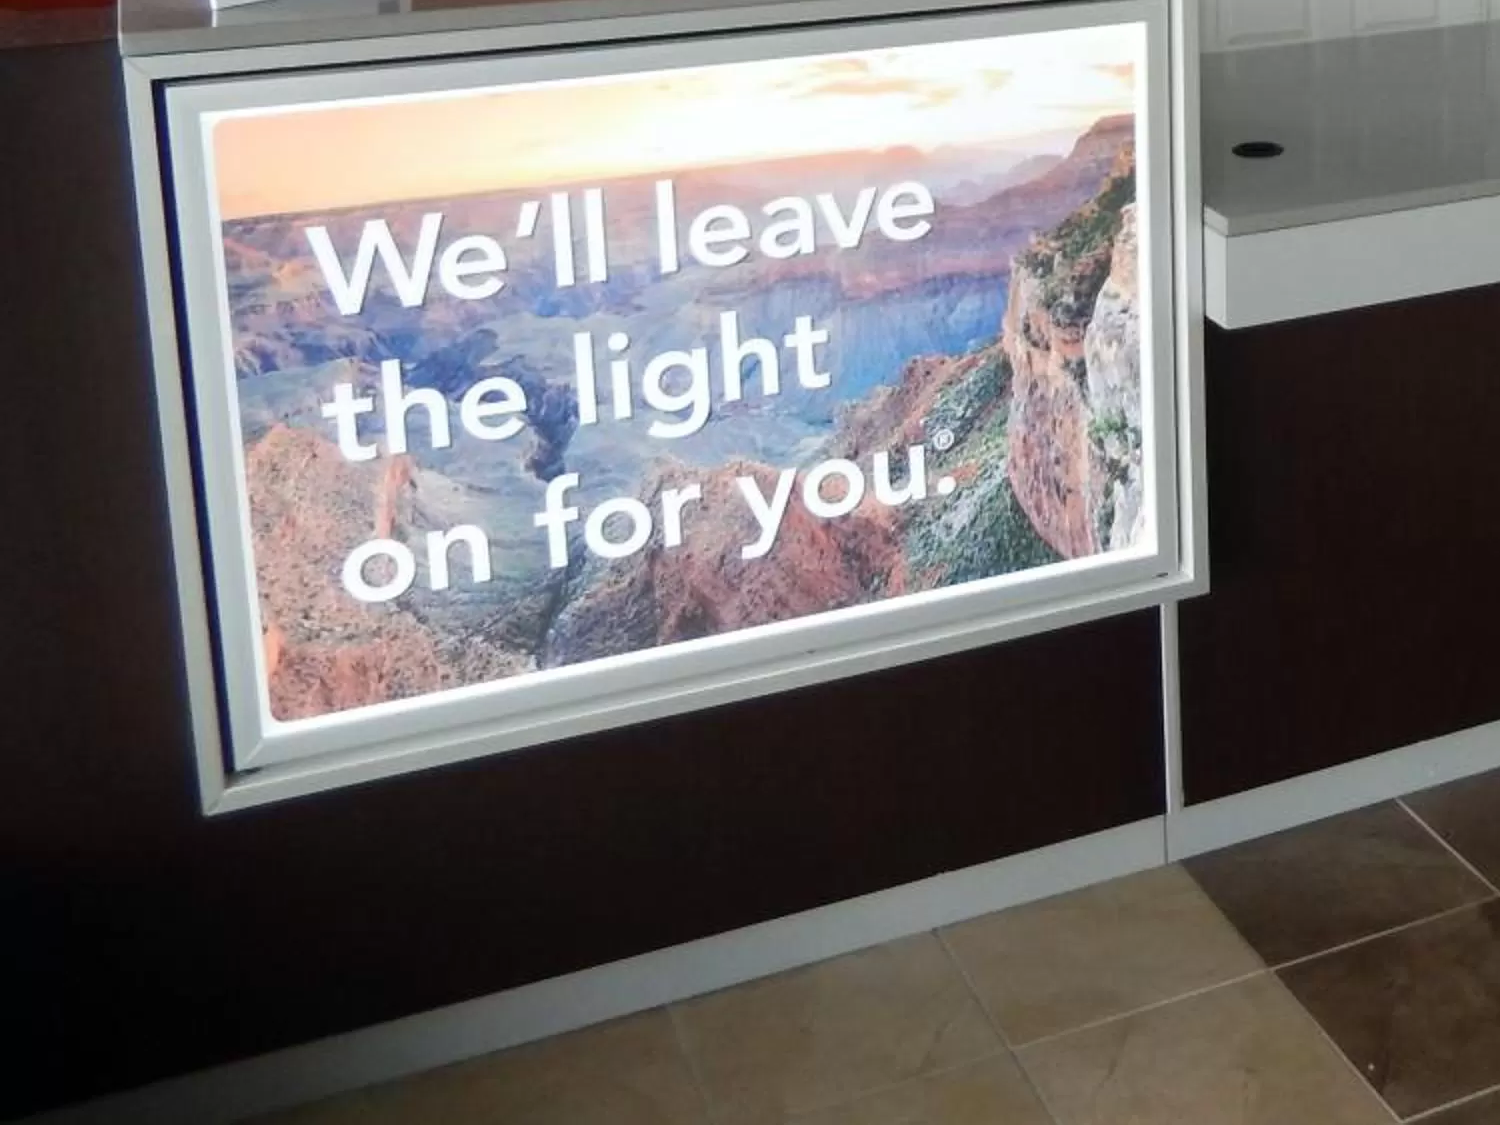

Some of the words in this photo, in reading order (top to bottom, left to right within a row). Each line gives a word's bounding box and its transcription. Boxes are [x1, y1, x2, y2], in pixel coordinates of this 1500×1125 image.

[655, 178, 937, 276] leave
[322, 360, 528, 463] the
[573, 309, 832, 439] light
[340, 523, 490, 605] on
[535, 473, 702, 569] for
